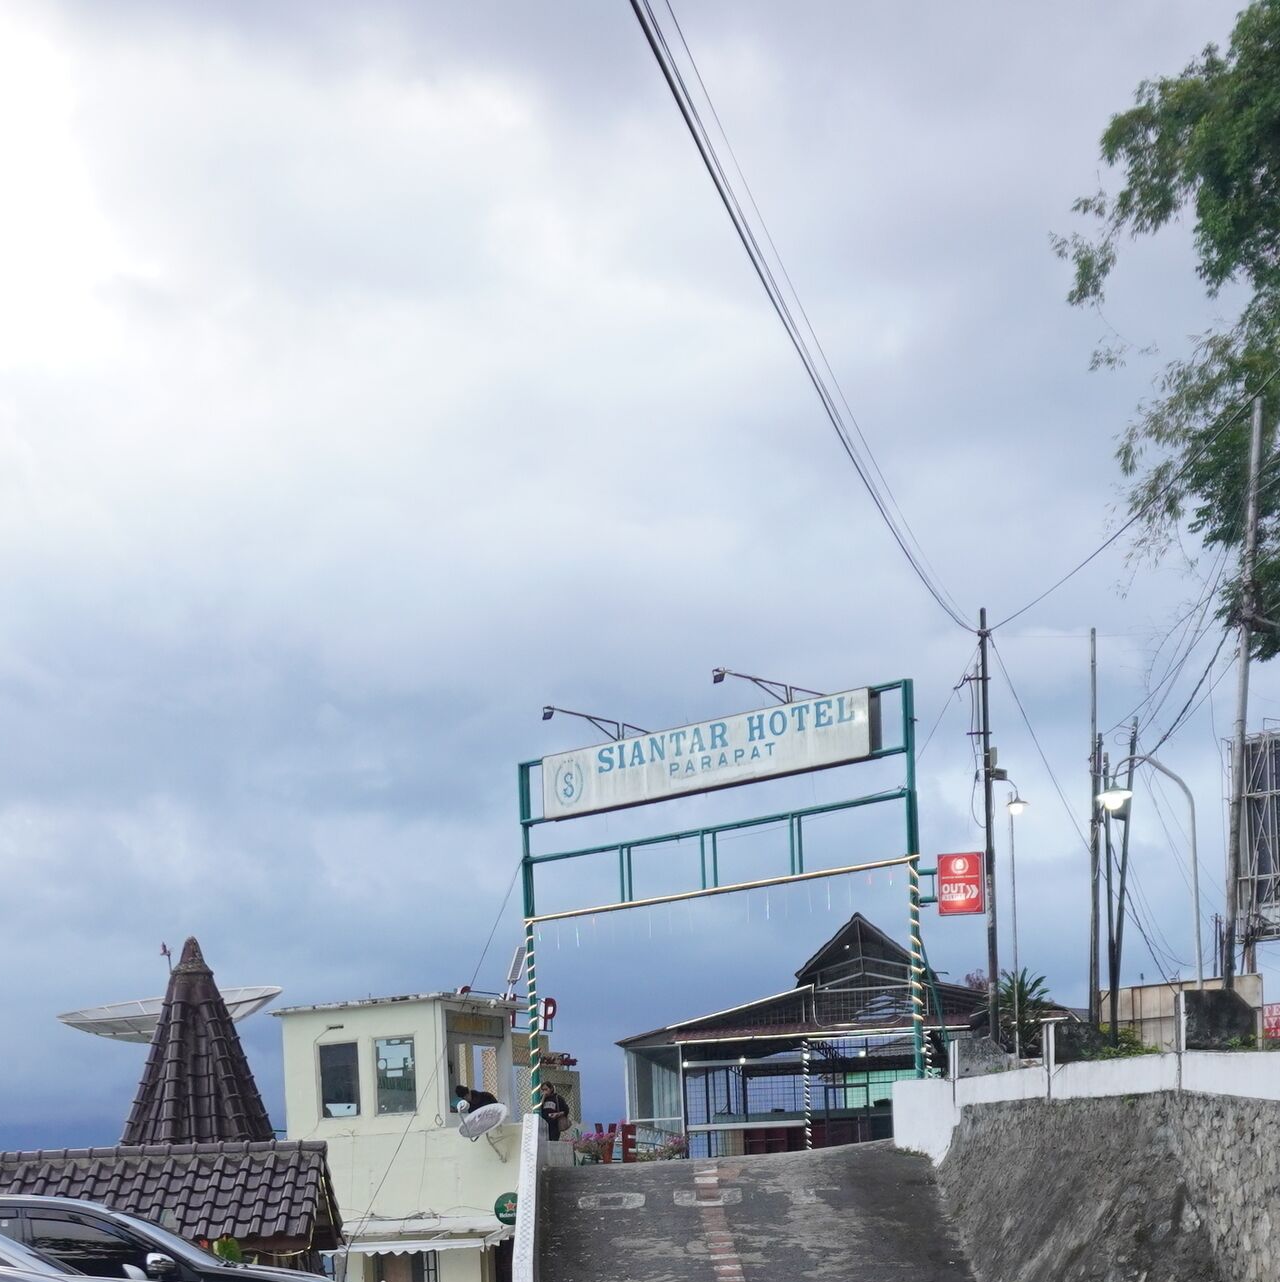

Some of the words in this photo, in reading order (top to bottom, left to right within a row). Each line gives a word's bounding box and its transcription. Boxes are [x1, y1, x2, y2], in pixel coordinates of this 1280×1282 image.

[597, 721, 729, 774] SIANTAR
[746, 696, 855, 742] HOTEL
[669, 742, 776, 777] PARAPAT
[942, 882, 966, 894] OUT
